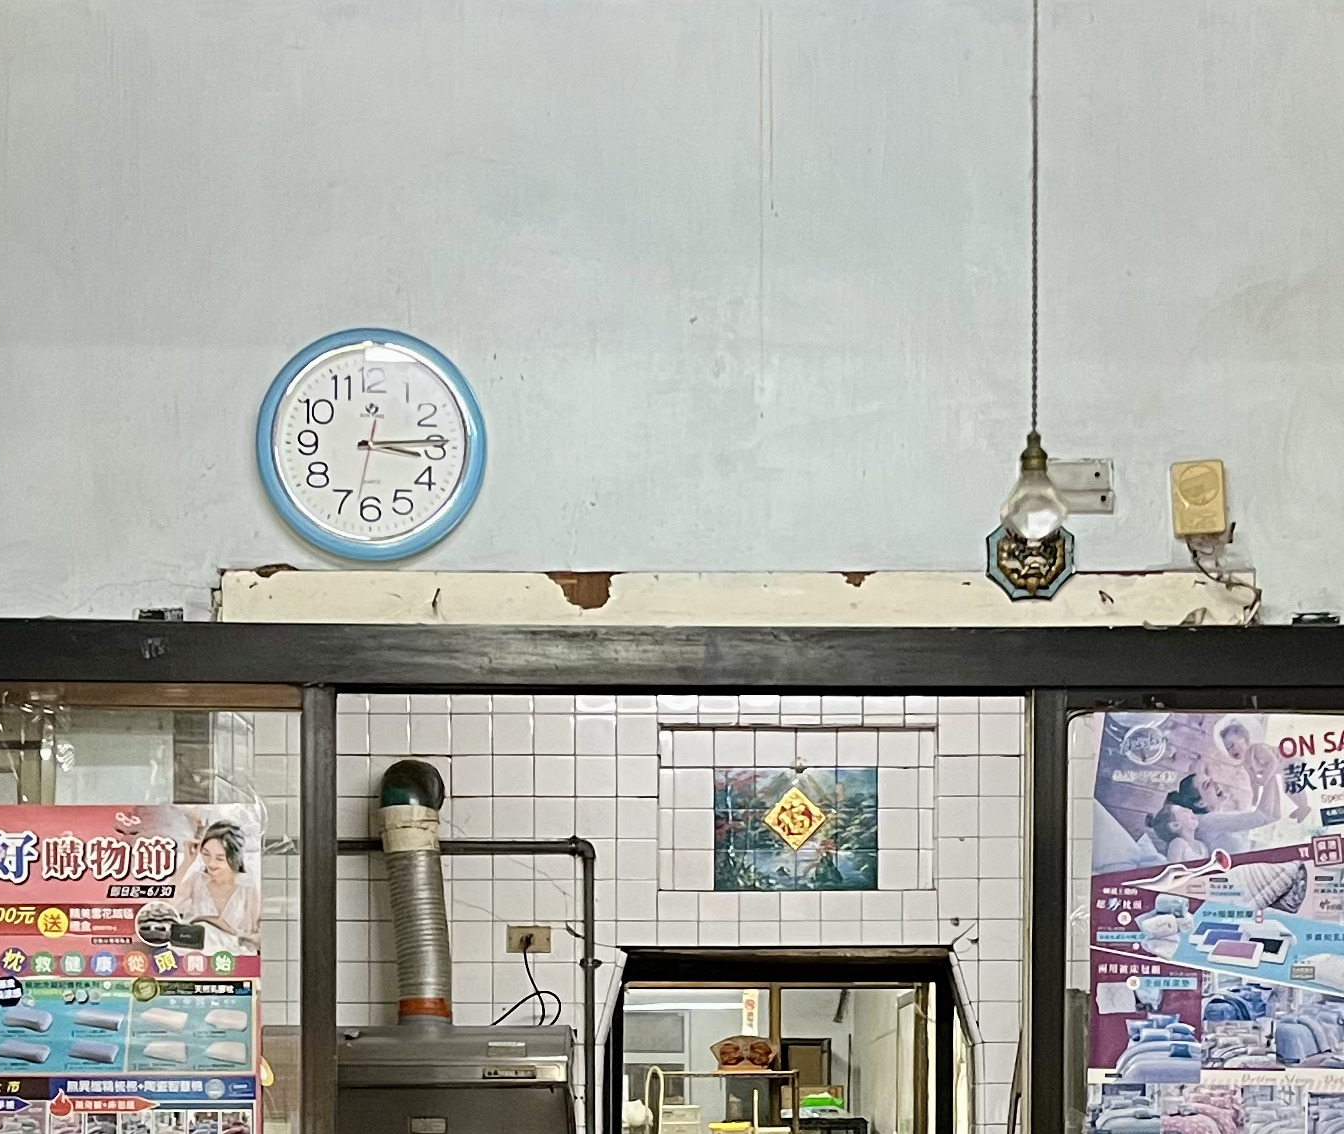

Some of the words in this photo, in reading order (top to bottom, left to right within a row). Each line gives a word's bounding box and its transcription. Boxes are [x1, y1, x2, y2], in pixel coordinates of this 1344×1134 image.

[332, 375, 352, 400] 11
[359, 366, 387, 393] 12
[305, 398, 334, 424] 10
[417, 403, 437, 427] 2
[297, 430, 319, 455] 9
[423, 434, 446, 460] 3
[306, 462, 330, 488] 8
[414, 466, 436, 491] 4
[333, 489, 353, 515] 7
[359, 497, 382, 522] 6
[392, 489, 414, 515] 5
[1279, 737, 1316, 758] ON
